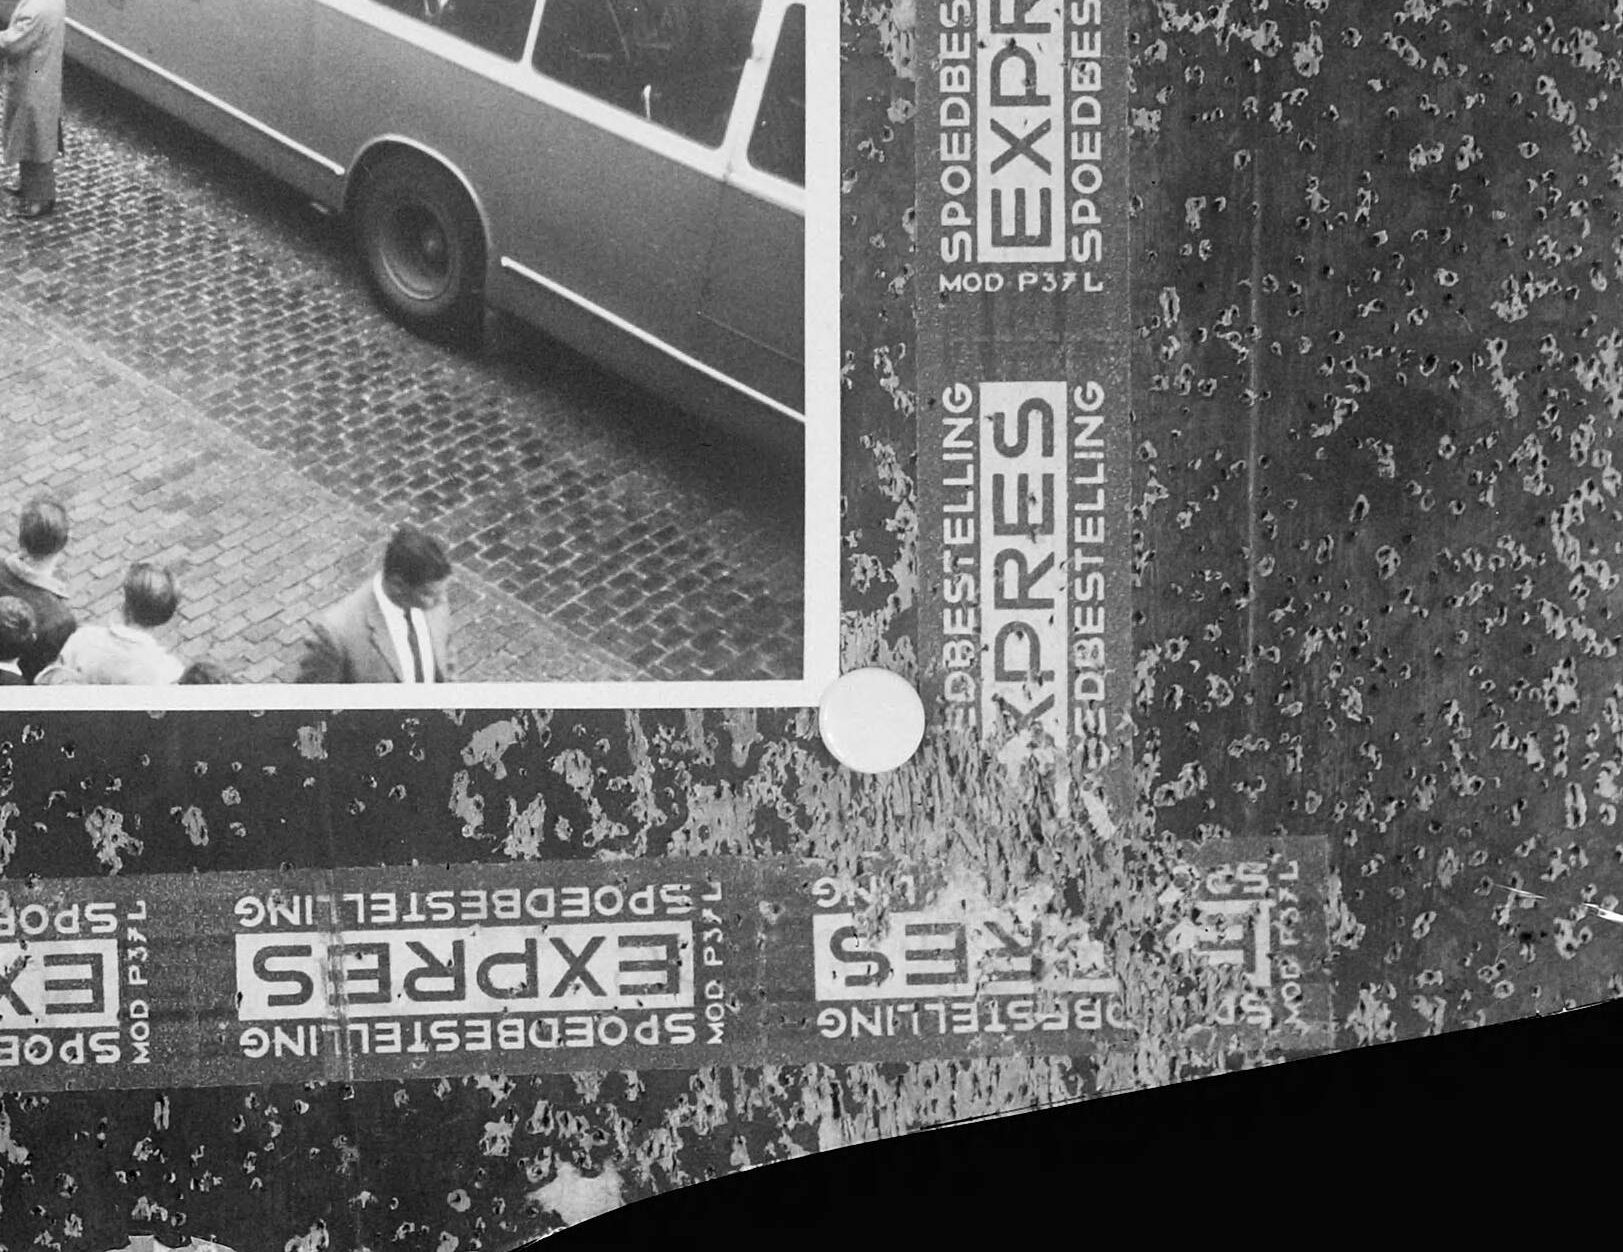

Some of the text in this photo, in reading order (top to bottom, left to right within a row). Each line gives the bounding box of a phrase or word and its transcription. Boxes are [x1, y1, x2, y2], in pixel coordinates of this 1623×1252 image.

[939, 272, 1004, 292] MOD
[252, 934, 679, 1007] EXPRES
[129, 999, 151, 1064] MOD
[704, 979, 725, 1045] MOD
